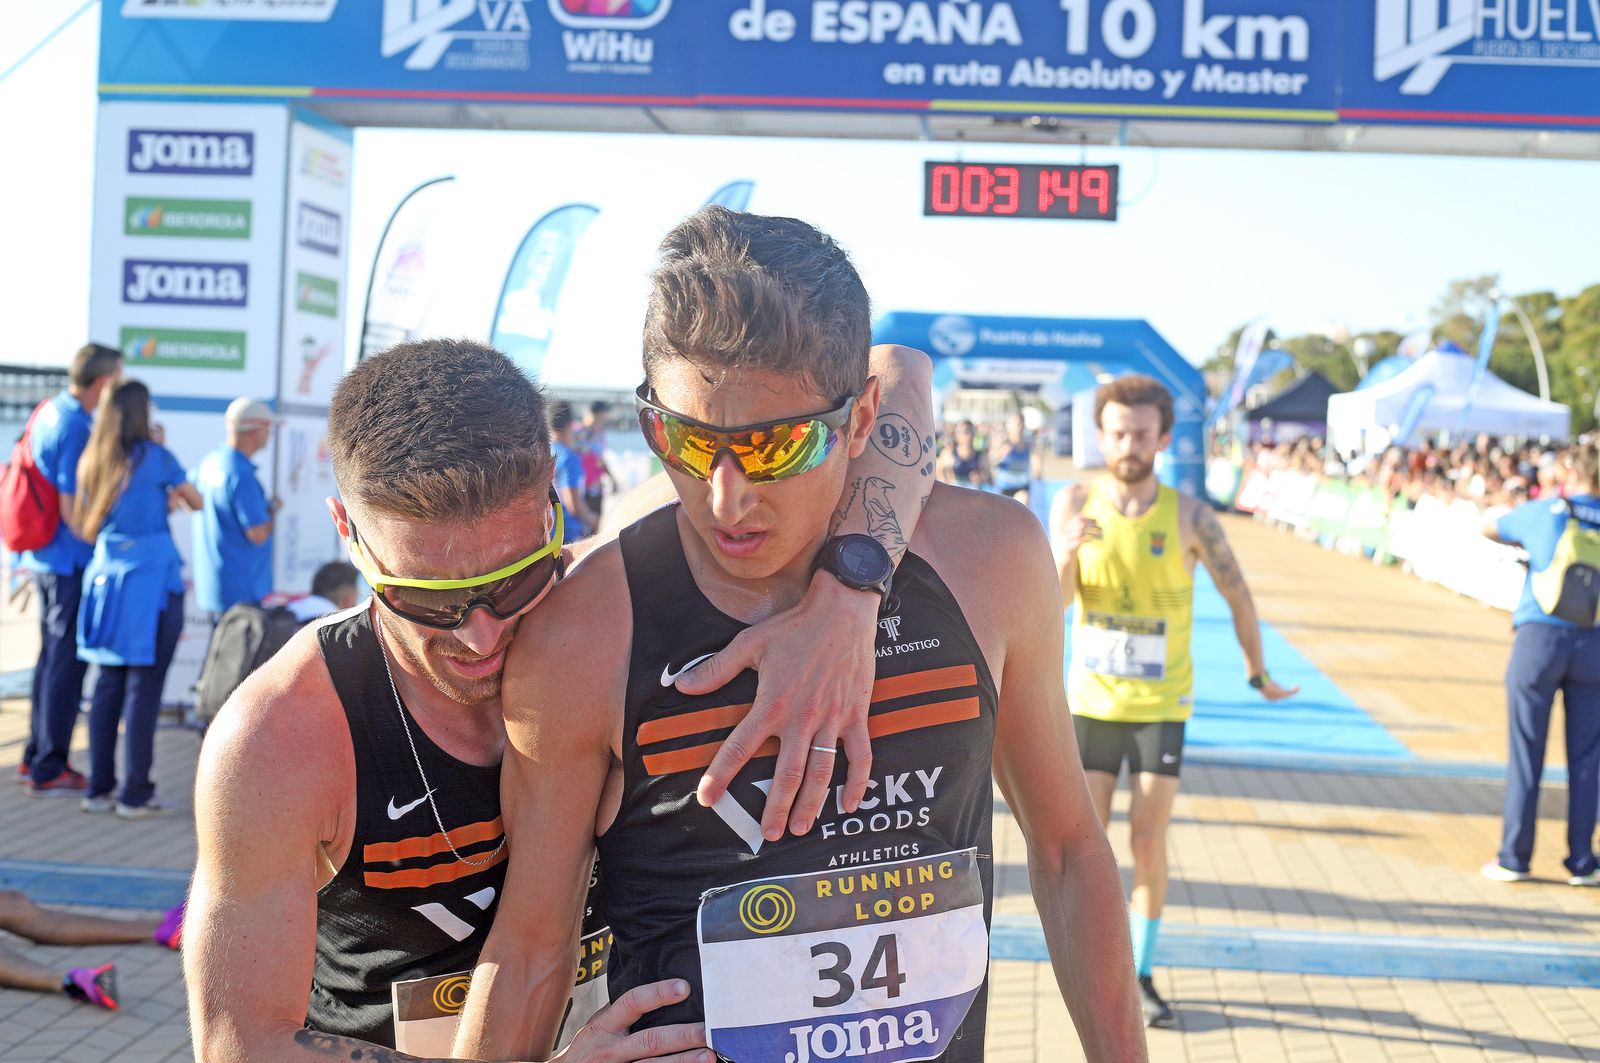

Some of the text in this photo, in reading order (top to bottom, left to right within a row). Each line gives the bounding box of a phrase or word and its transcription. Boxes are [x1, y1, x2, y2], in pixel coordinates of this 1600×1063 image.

[562, 29, 654, 63] WiHu
[728, 0, 1310, 61] de ESPAÑA 10 km
[882, 57, 1309, 99] en ruta Absoluto y Master
[895, 639, 940, 655] POSTIGO
[822, 807, 930, 840] FOODS
[828, 843, 920, 867] ATHLETICS
[816, 861, 953, 898] RUNNING
[855, 893, 936, 920] LOOP
[810, 933, 907, 1008] 34
